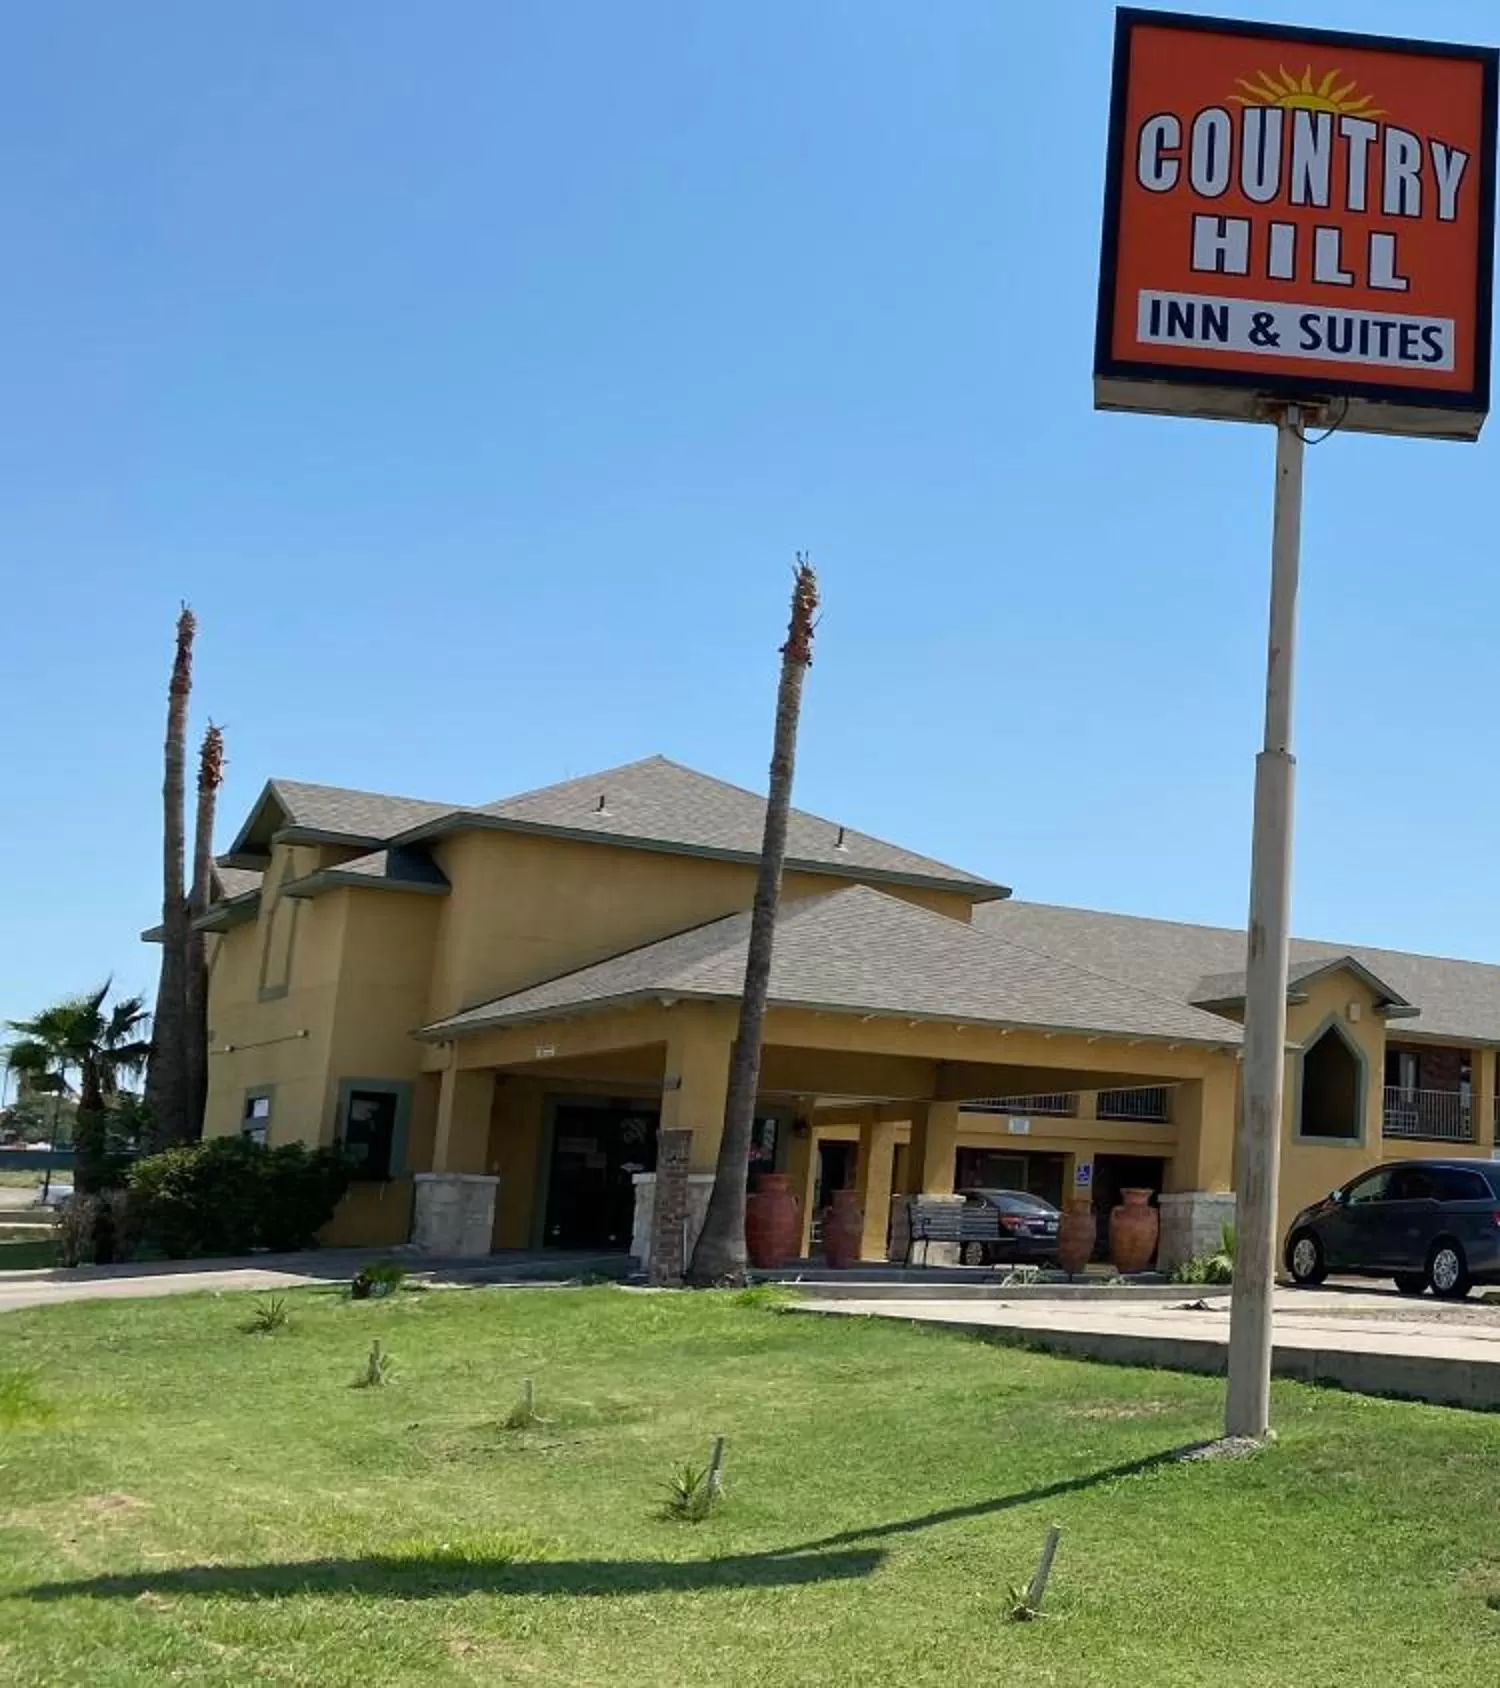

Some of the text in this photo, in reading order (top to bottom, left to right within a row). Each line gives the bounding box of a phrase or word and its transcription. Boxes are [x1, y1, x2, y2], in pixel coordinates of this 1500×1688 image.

[1136, 105, 1470, 222] COUNTRY
[1190, 213, 1410, 292] HILL
[1149, 299, 1444, 363] INN & SUITES
